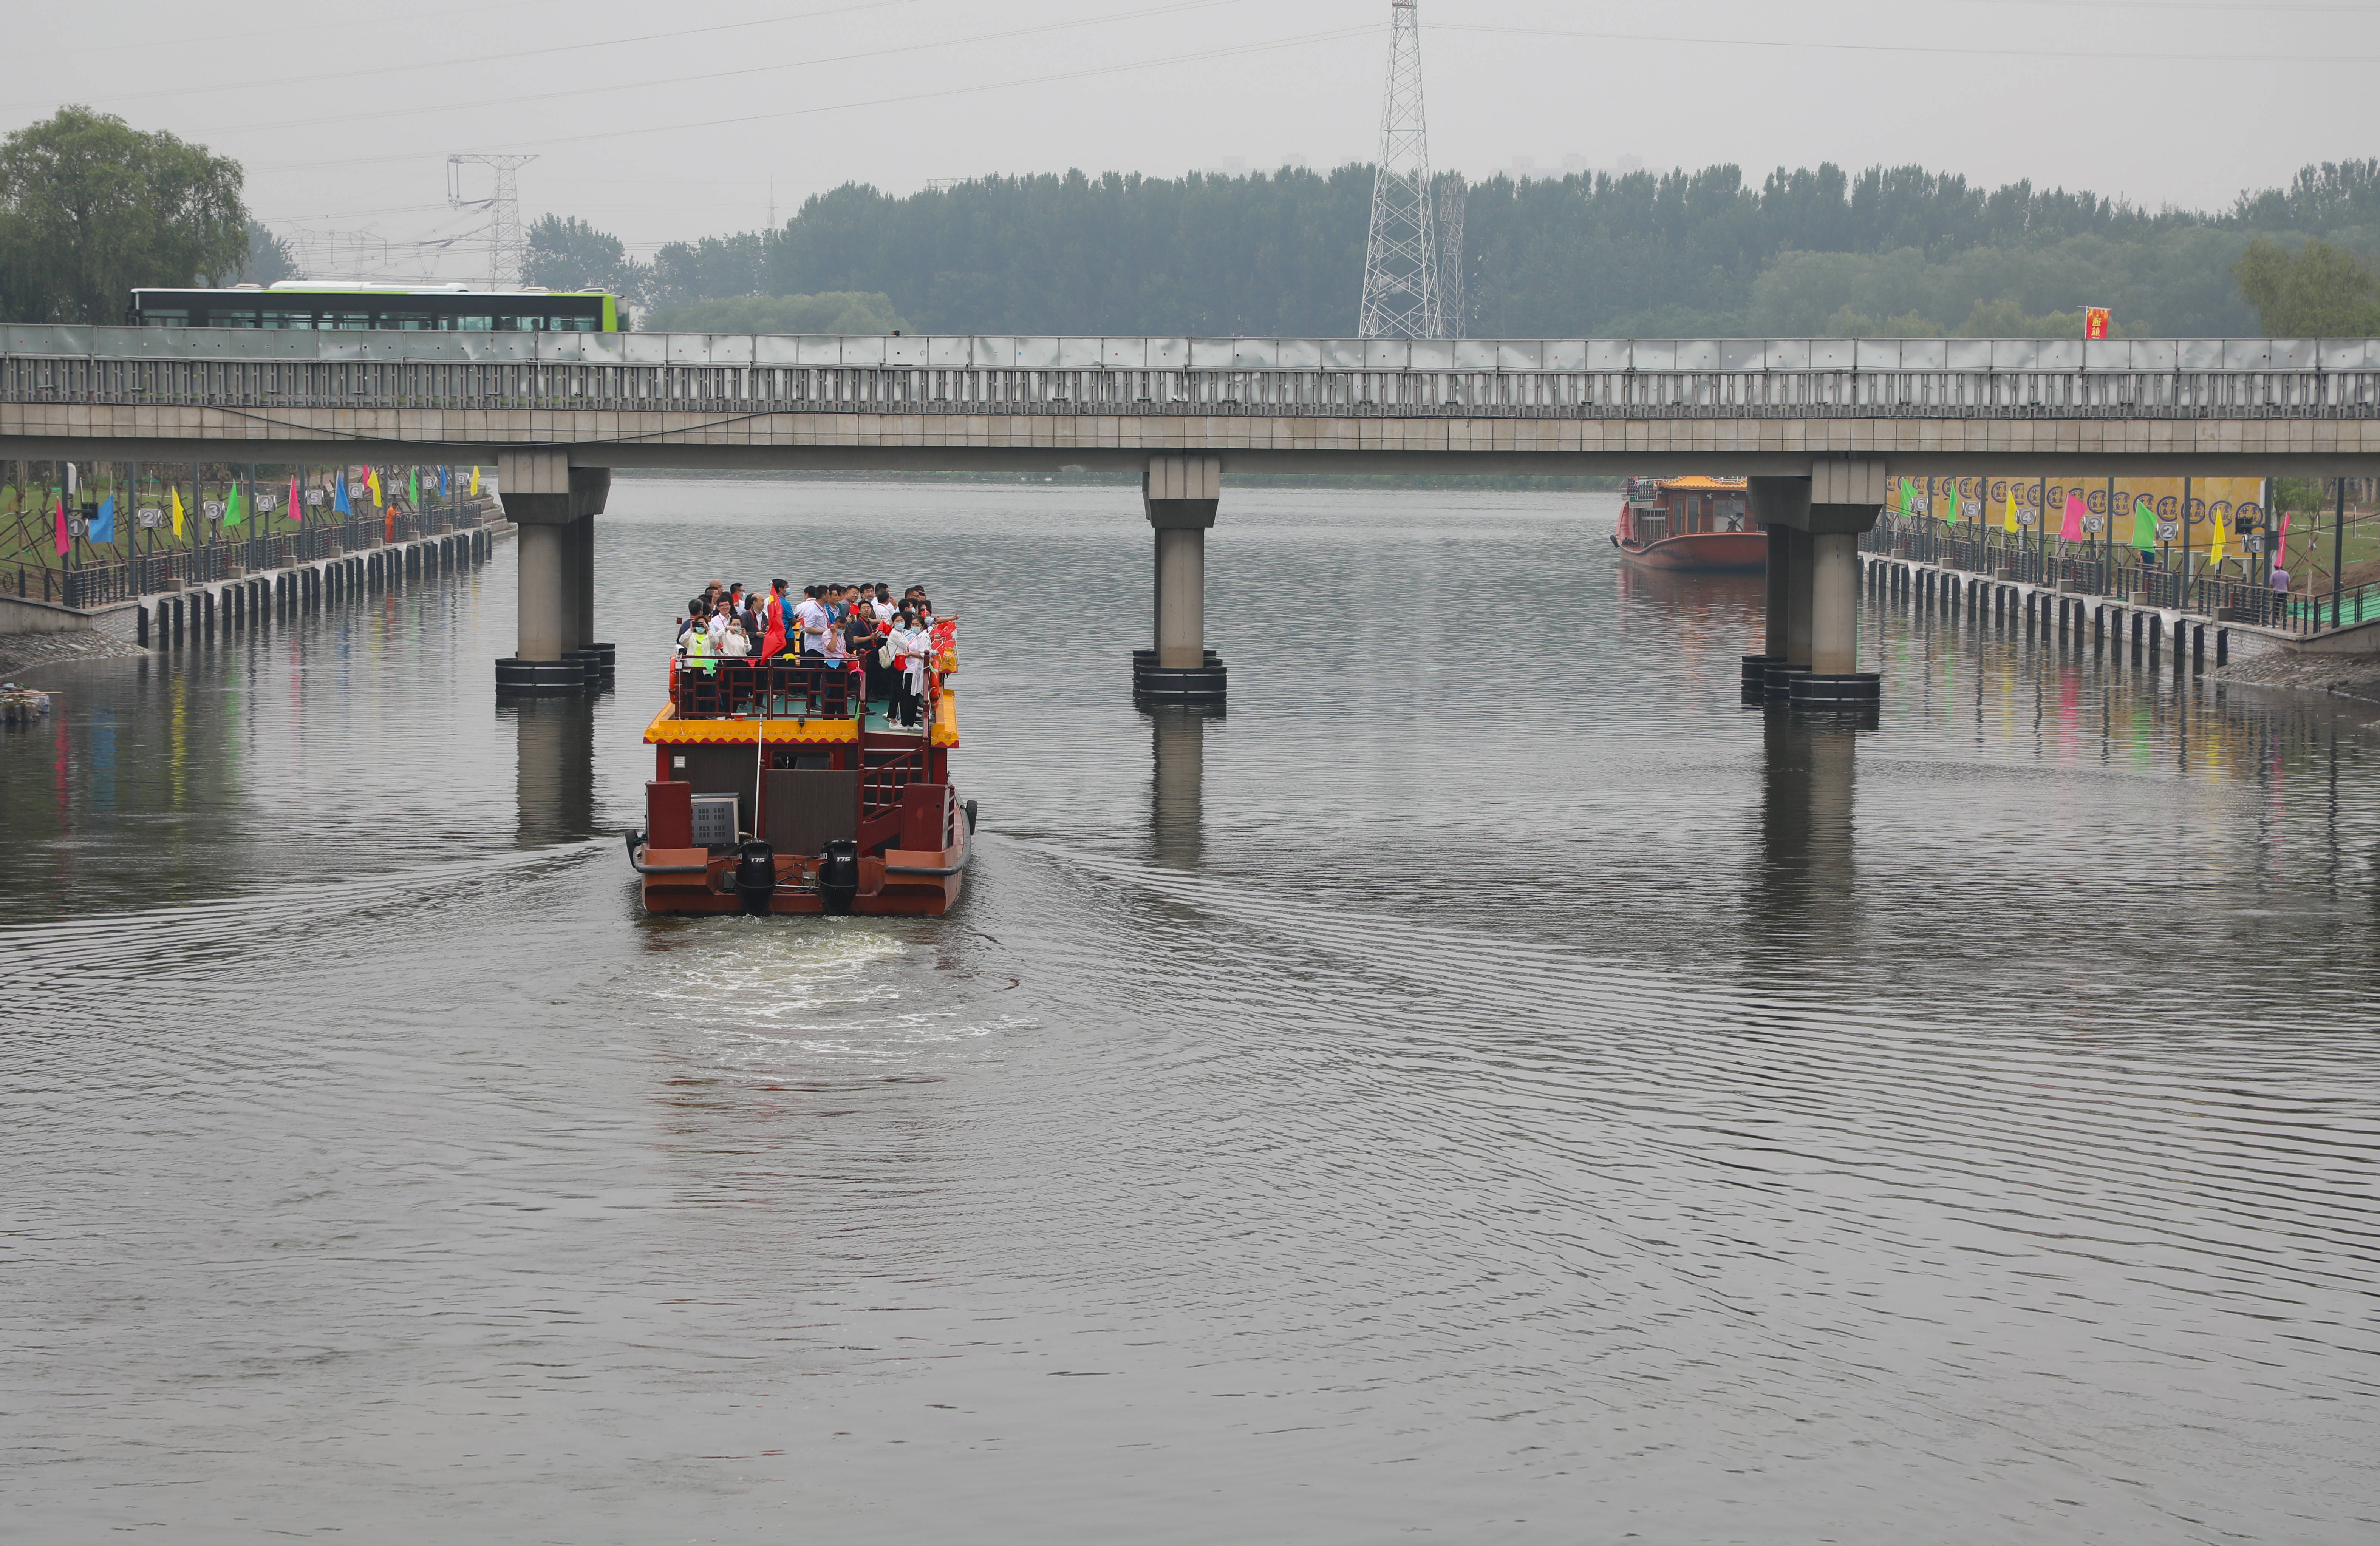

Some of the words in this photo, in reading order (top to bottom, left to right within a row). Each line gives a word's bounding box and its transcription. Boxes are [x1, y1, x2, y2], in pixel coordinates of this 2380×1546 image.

[426, 479, 432, 487] 8
[352, 487, 359, 497] 6
[390, 484, 397, 493] 7
[261, 498, 269, 508] 4
[310, 493, 318, 503] 5
[1917, 499, 1925, 509] 6
[209, 505, 218, 516] 3
[1968, 505, 1976, 515] 5
[144, 512, 153, 524] 2
[2023, 512, 2031, 523] 4
[70, 521, 78, 534] 1
[2090, 519, 2099, 530] 3
[2163, 526, 2173, 537] 2
[2253, 538, 2260, 550] 1
